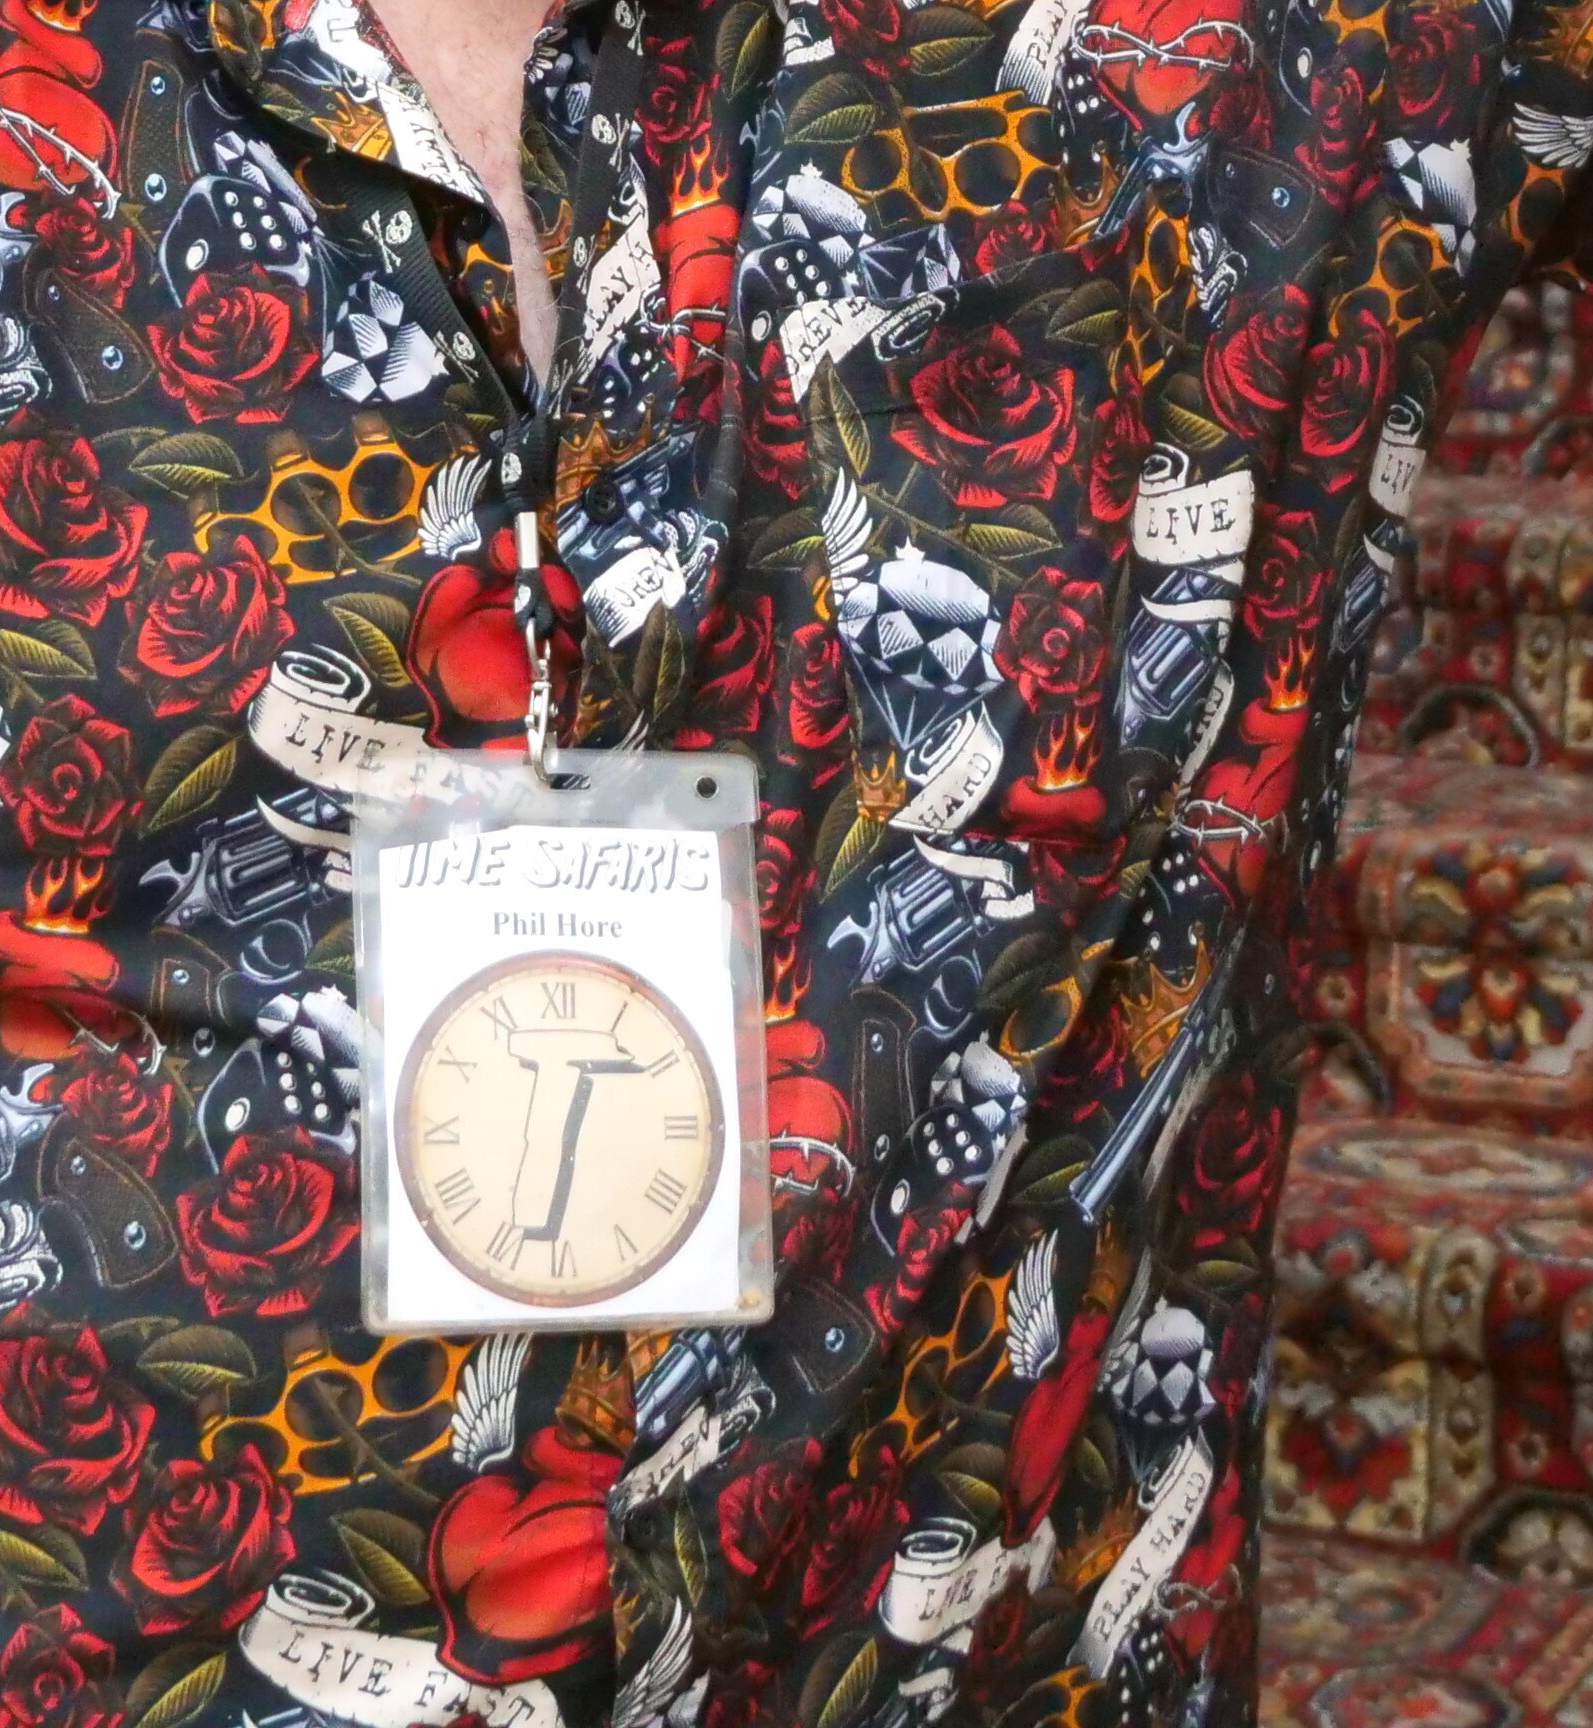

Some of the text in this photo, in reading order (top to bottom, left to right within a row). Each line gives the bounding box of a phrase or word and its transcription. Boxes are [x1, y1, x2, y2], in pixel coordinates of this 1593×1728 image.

[1146, 498, 1236, 545] LIVE
[285, 712, 386, 772] LIVE
[493, 911, 624, 939] Phil Hore
[540, 982, 577, 1020] XII
[437, 1044, 479, 1084] X
[1092, 1473, 1206, 1641] PLAY HARD
[278, 1629, 394, 1697] LIVE
